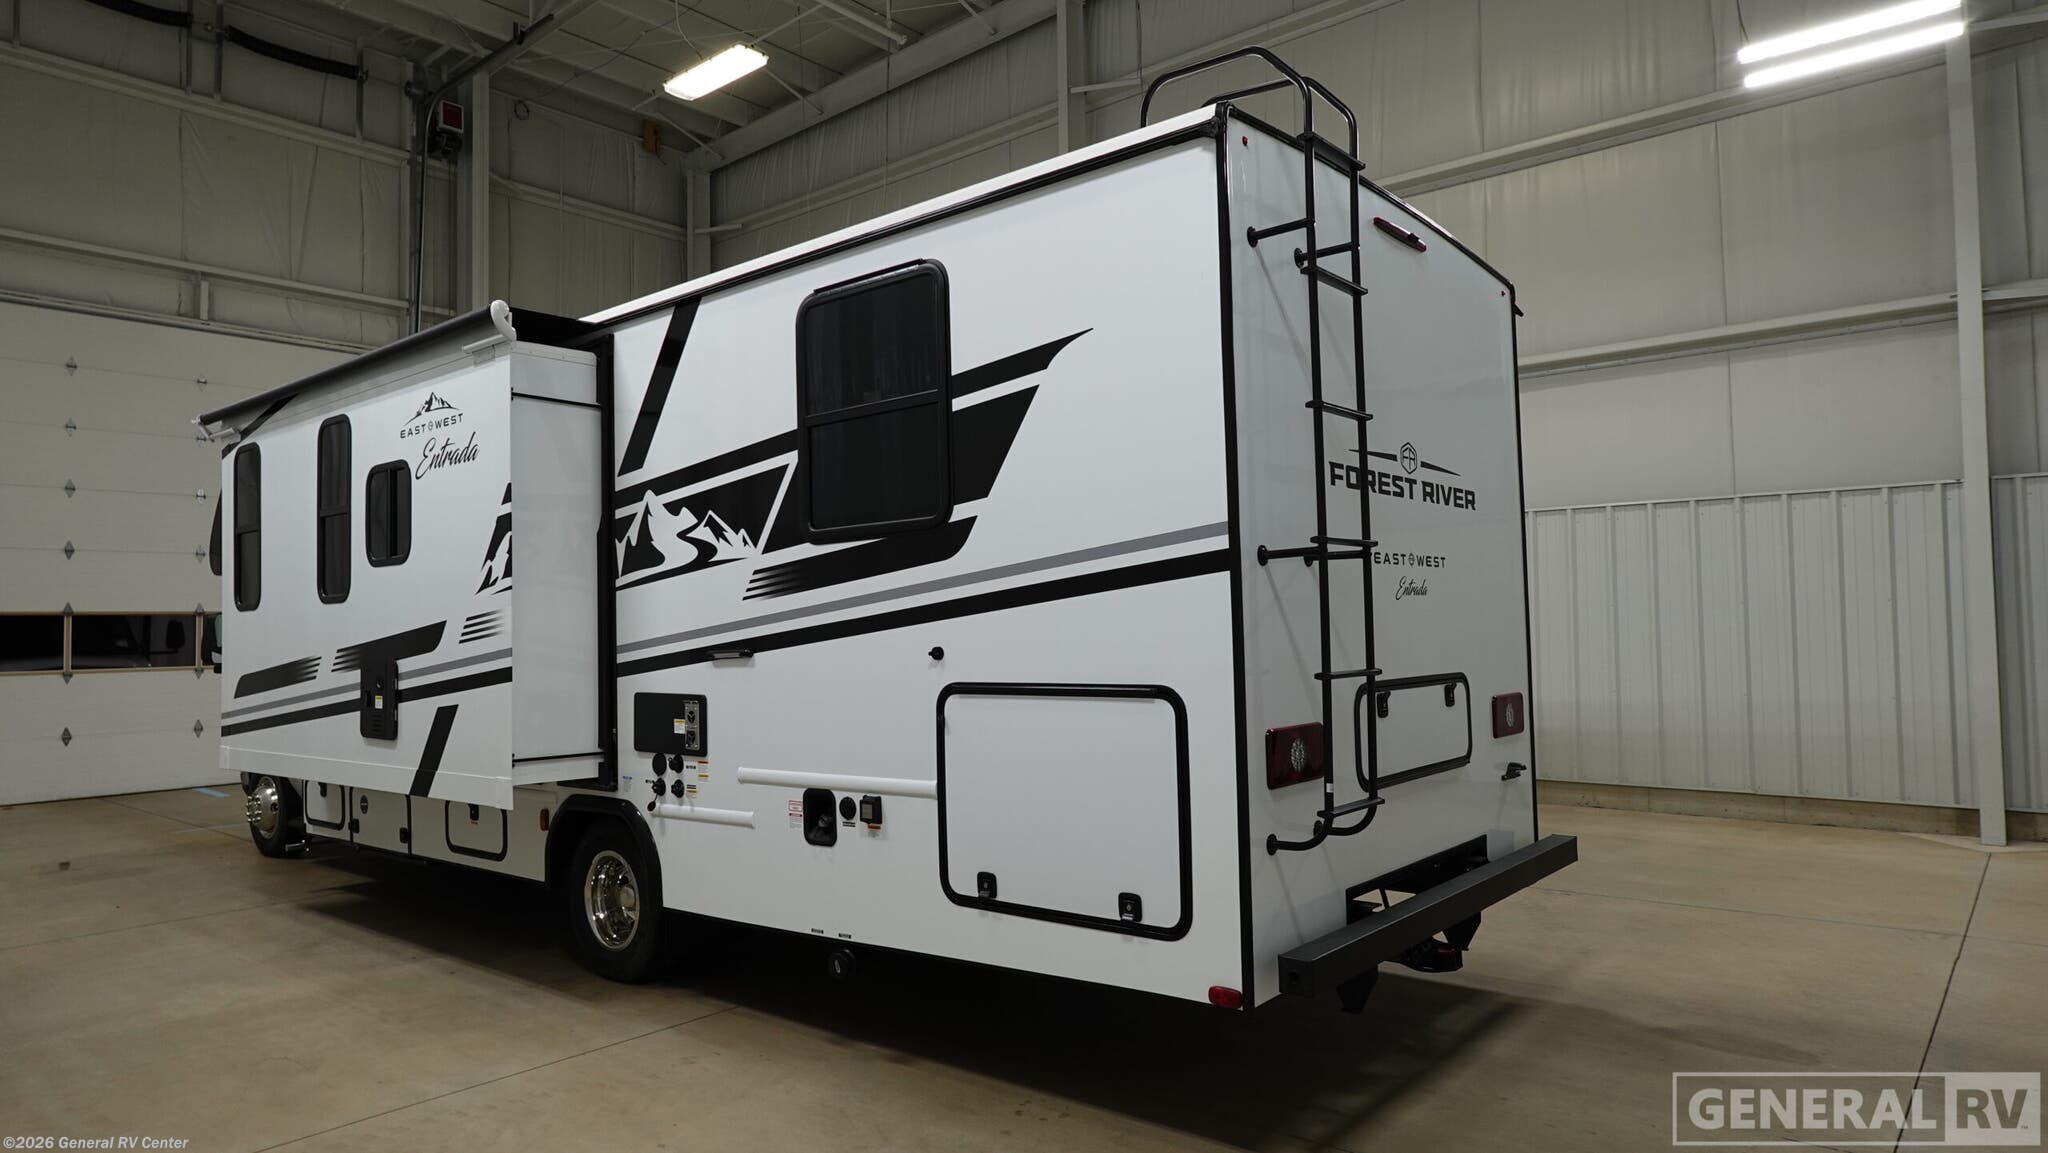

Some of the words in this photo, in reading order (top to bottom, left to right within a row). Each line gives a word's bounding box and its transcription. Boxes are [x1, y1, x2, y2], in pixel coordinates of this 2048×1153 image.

[400, 424, 426, 439] EAST
[435, 413, 463, 429] WEST
[415, 431, 479, 480] Entrada
[1328, 461, 1417, 500] FOREST
[1421, 480, 1476, 511] RIVER
[1374, 552, 1406, 566] EAST
[1416, 555, 1446, 568] WEST
[1395, 575, 1428, 600] Entrada
